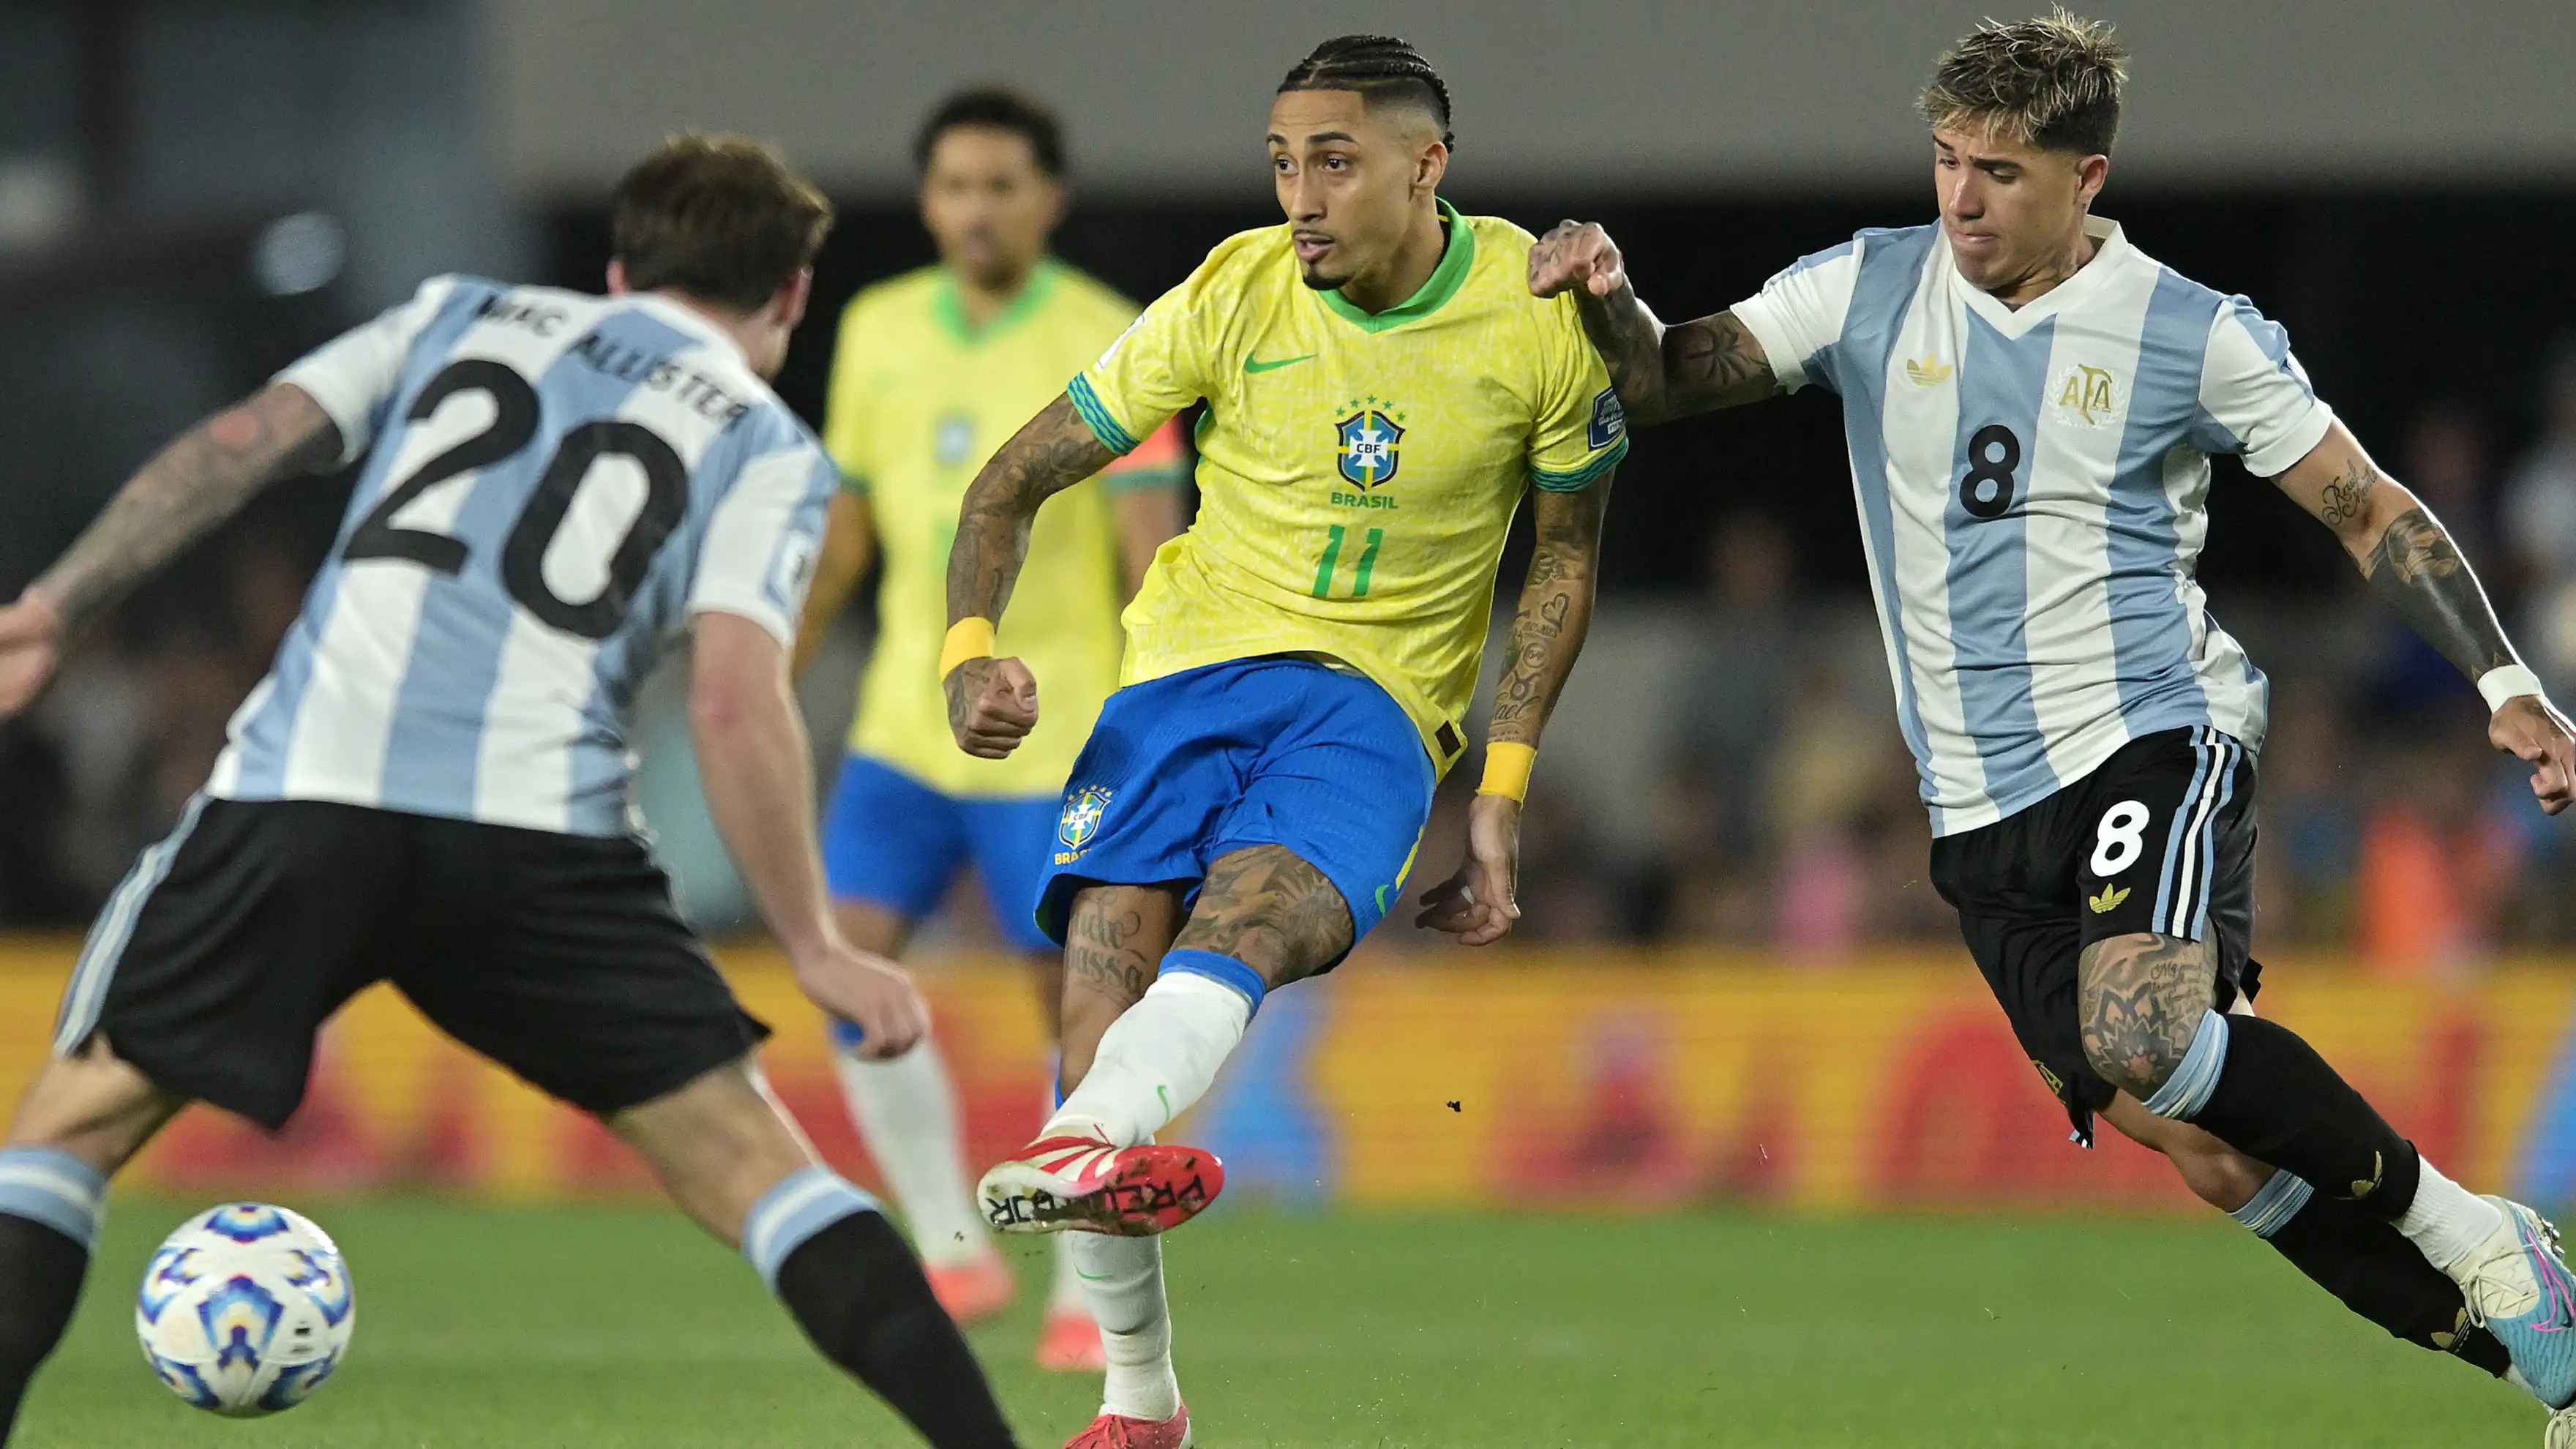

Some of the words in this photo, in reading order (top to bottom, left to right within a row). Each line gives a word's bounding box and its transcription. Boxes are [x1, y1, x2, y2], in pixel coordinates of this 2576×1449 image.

[1357, 443, 1382, 454] CBF
[1959, 424, 2021, 518] 8
[342, 359, 689, 639] 20
[1330, 492, 1399, 509] BRASIL
[1312, 525, 1383, 597] 11
[2090, 800, 2150, 877] 8
